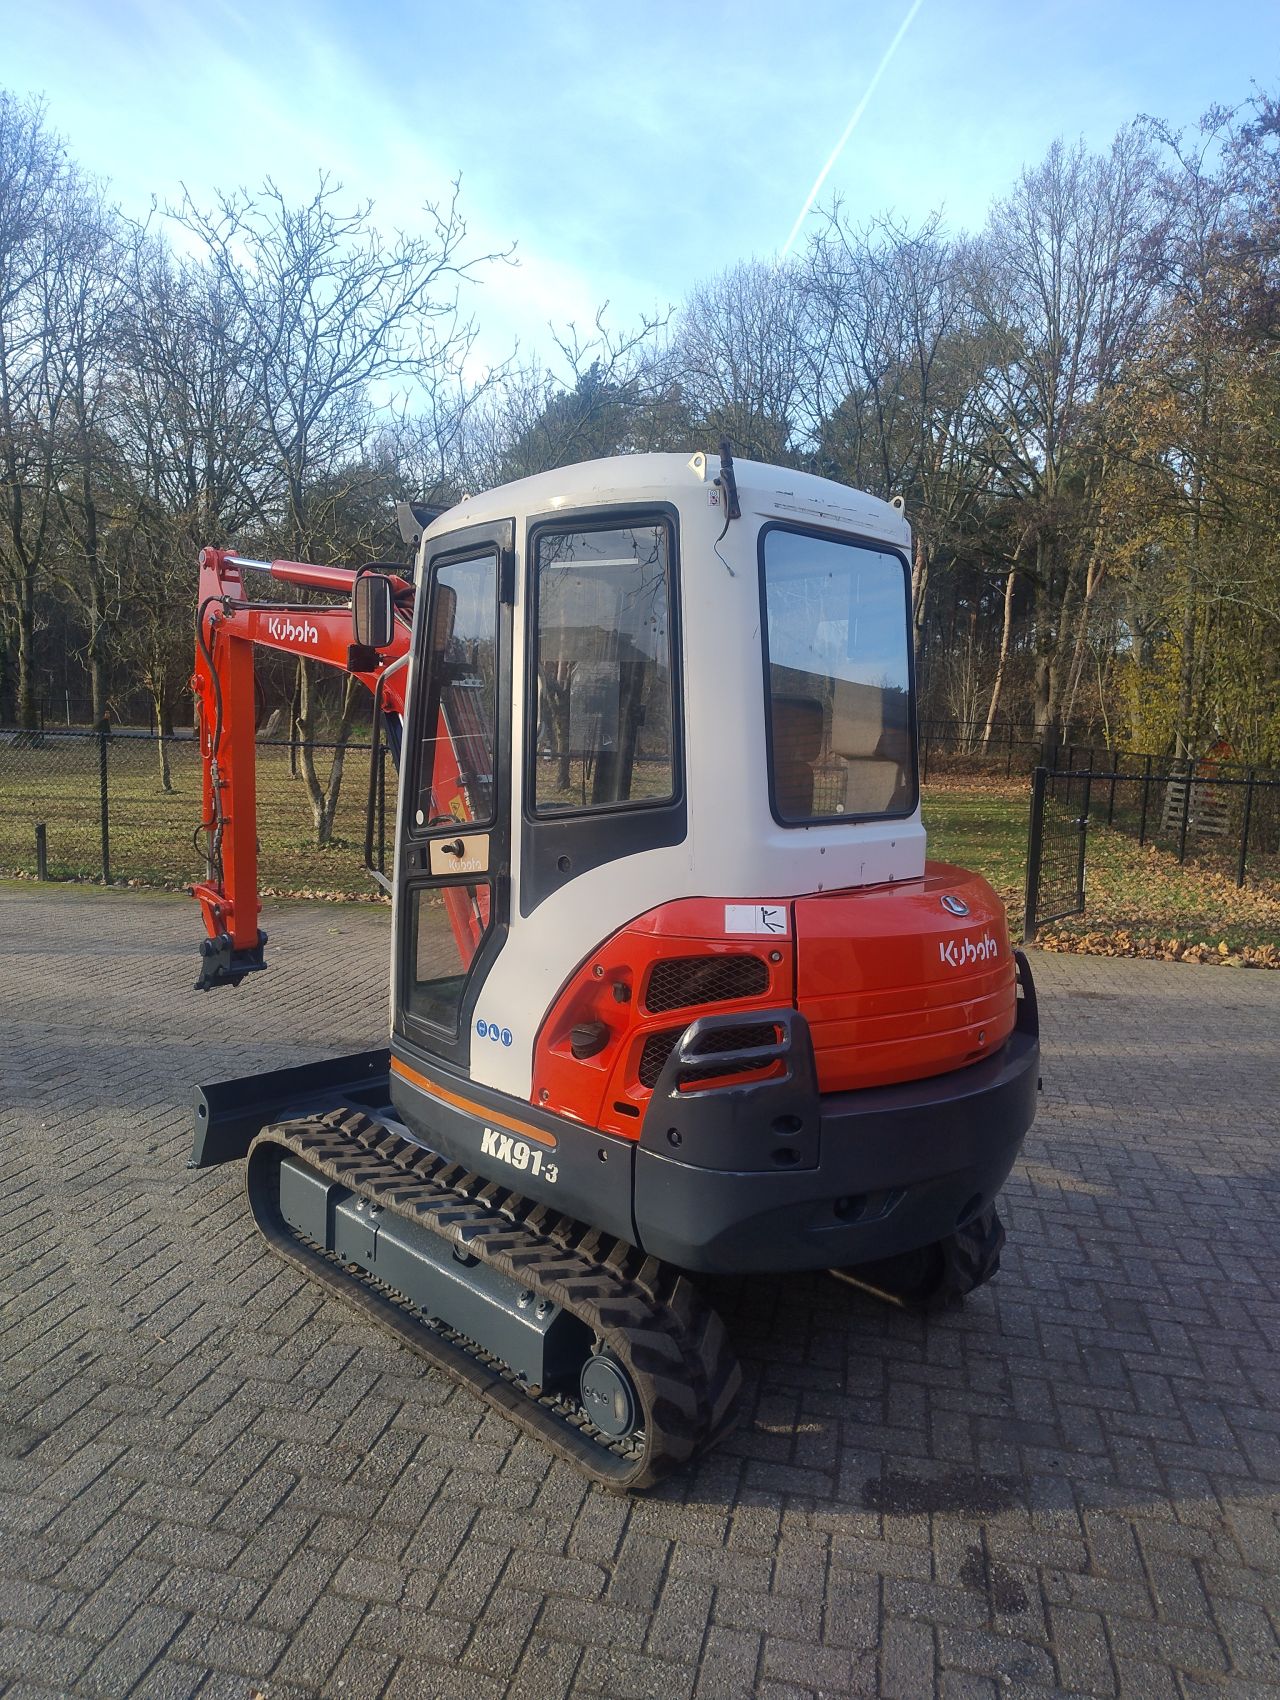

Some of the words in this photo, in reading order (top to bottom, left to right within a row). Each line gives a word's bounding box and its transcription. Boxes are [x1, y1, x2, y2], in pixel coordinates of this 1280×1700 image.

[268, 618, 318, 643] Kubota
[448, 858, 482, 872] Kubota
[939, 933, 998, 967] Kubota
[480, 1127, 559, 1183] KX91-3
